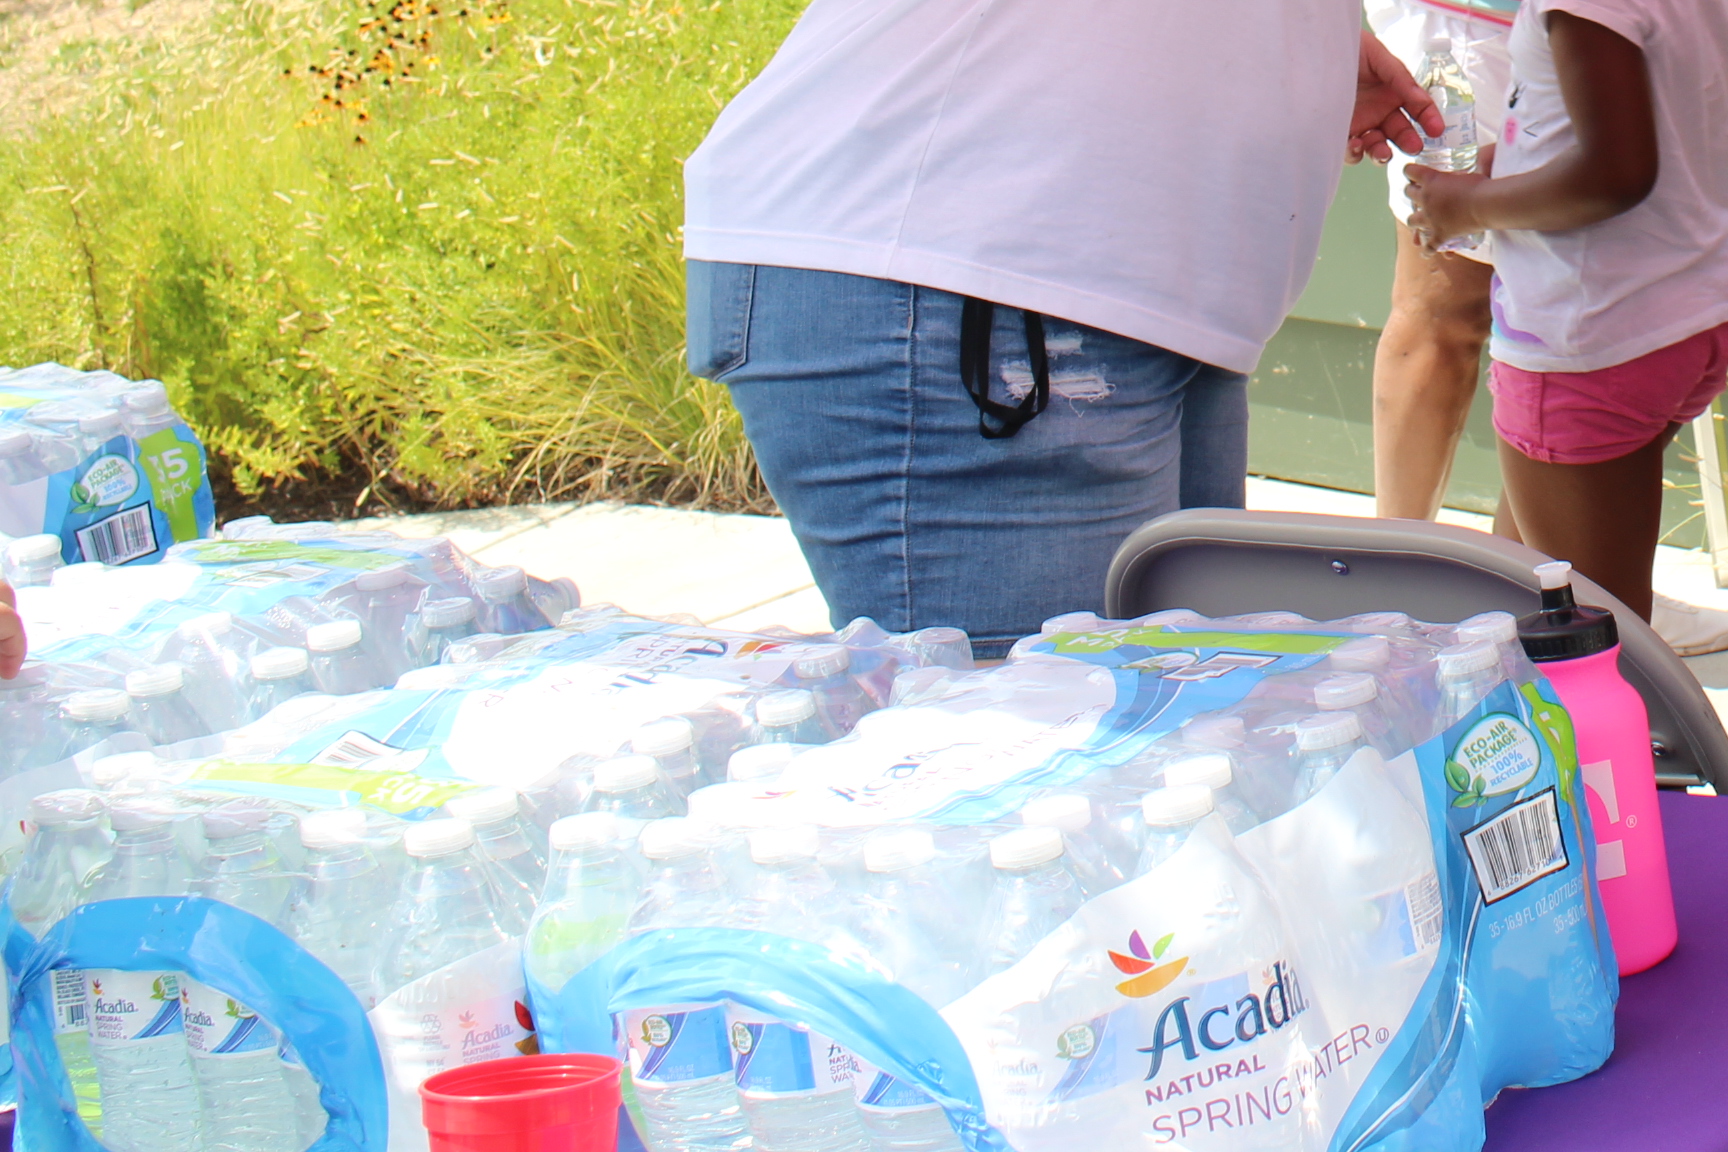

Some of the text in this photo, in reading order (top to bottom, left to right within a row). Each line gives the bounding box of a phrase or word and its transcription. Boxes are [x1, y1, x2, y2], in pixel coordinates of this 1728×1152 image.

[1462, 719, 1509, 759] ECO-AIR
[1469, 729, 1518, 769] PACKAGE
[1490, 749, 1523, 775] 100%
[1490, 757, 1534, 787] RECYCLABLE
[1523, 906, 1536, 924] FL
[1535, 897, 1549, 918] OZ
[1547, 877, 1578, 912] BOTTLES
[94, 997, 135, 1015] Acadia
[183, 1007, 212, 1027] Acadia
[1135, 958, 1306, 1083] Acadia
[461, 1023, 513, 1051] Acadia
[1144, 1054, 1267, 1107] NATURAL
[1152, 1075, 1293, 1145] SPRING
[1295, 1022, 1373, 1100] WATER
